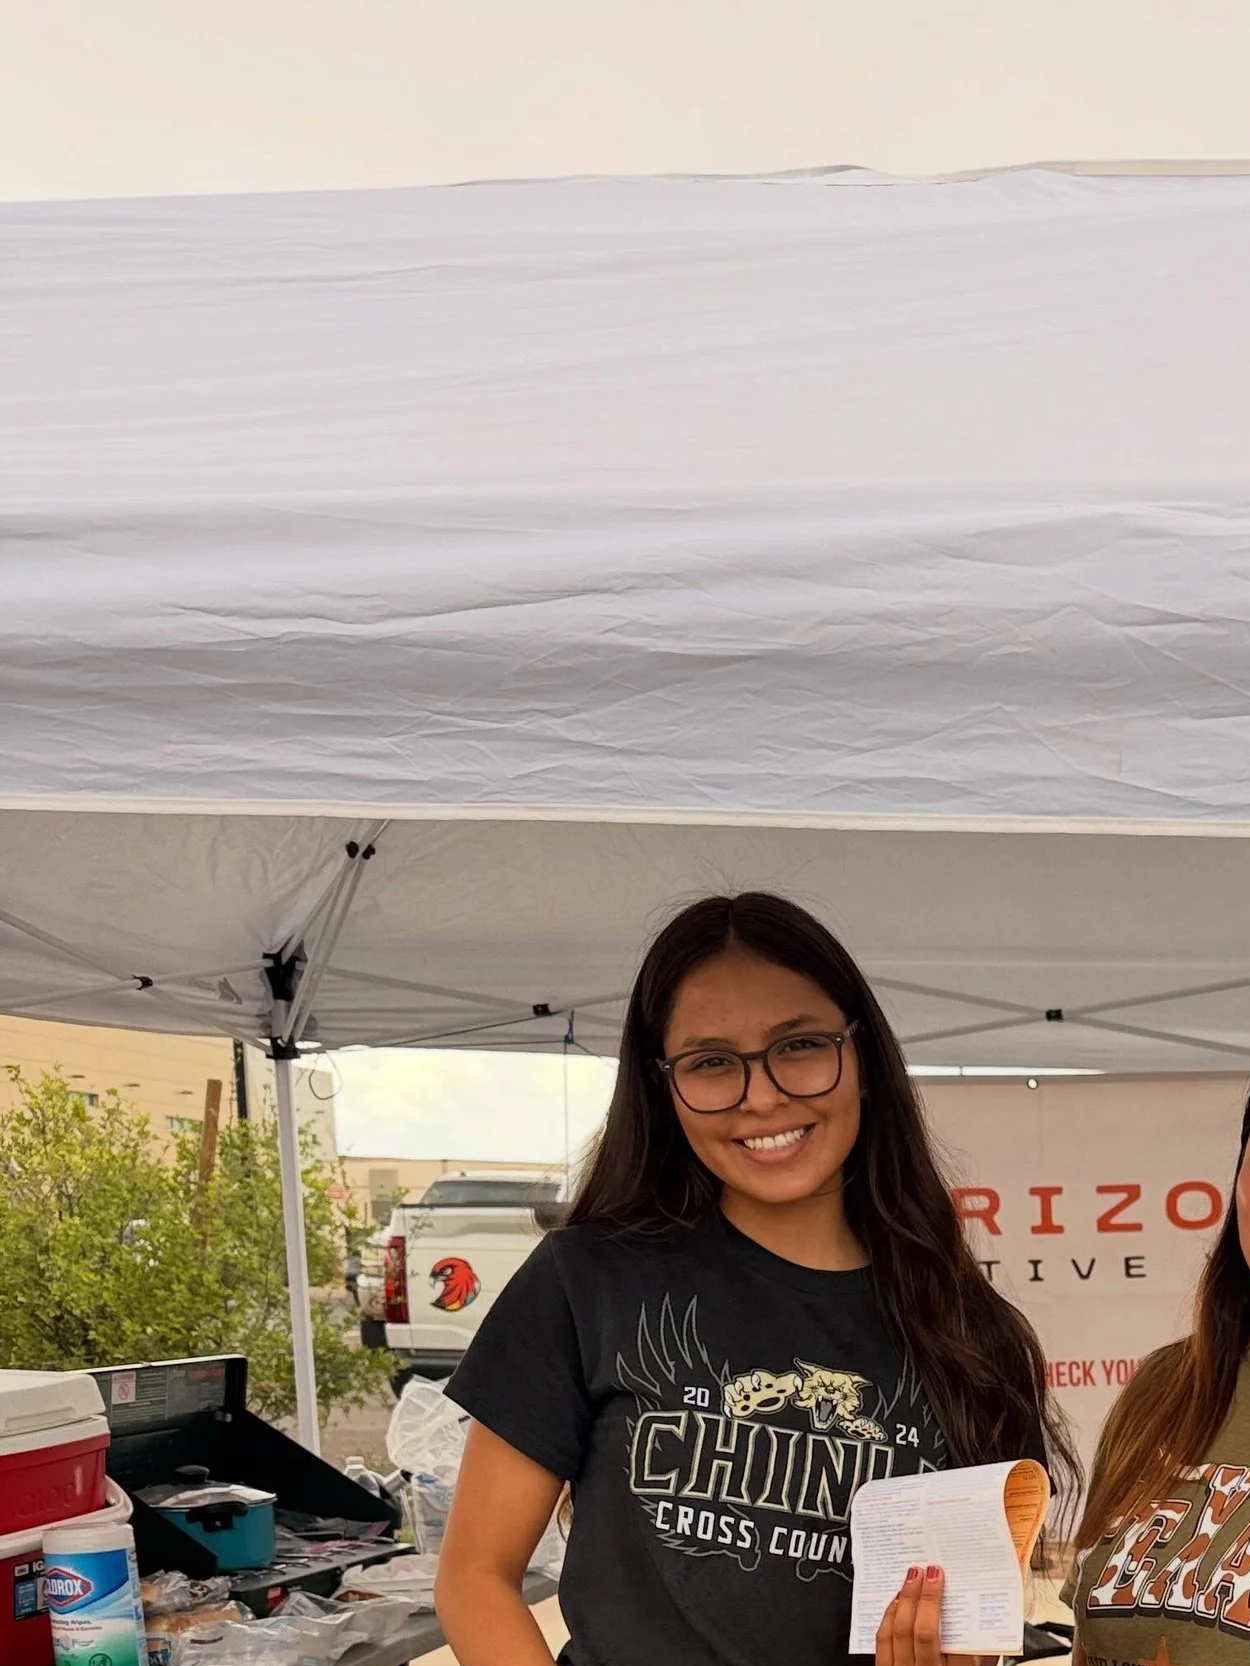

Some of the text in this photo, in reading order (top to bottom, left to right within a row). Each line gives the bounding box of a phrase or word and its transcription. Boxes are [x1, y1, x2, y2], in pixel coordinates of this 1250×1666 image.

[682, 1386, 710, 1408] 20
[895, 1423, 920, 1449] 24
[628, 1409, 938, 1526] CHIN
[655, 1500, 853, 1564] CROSS COUN
